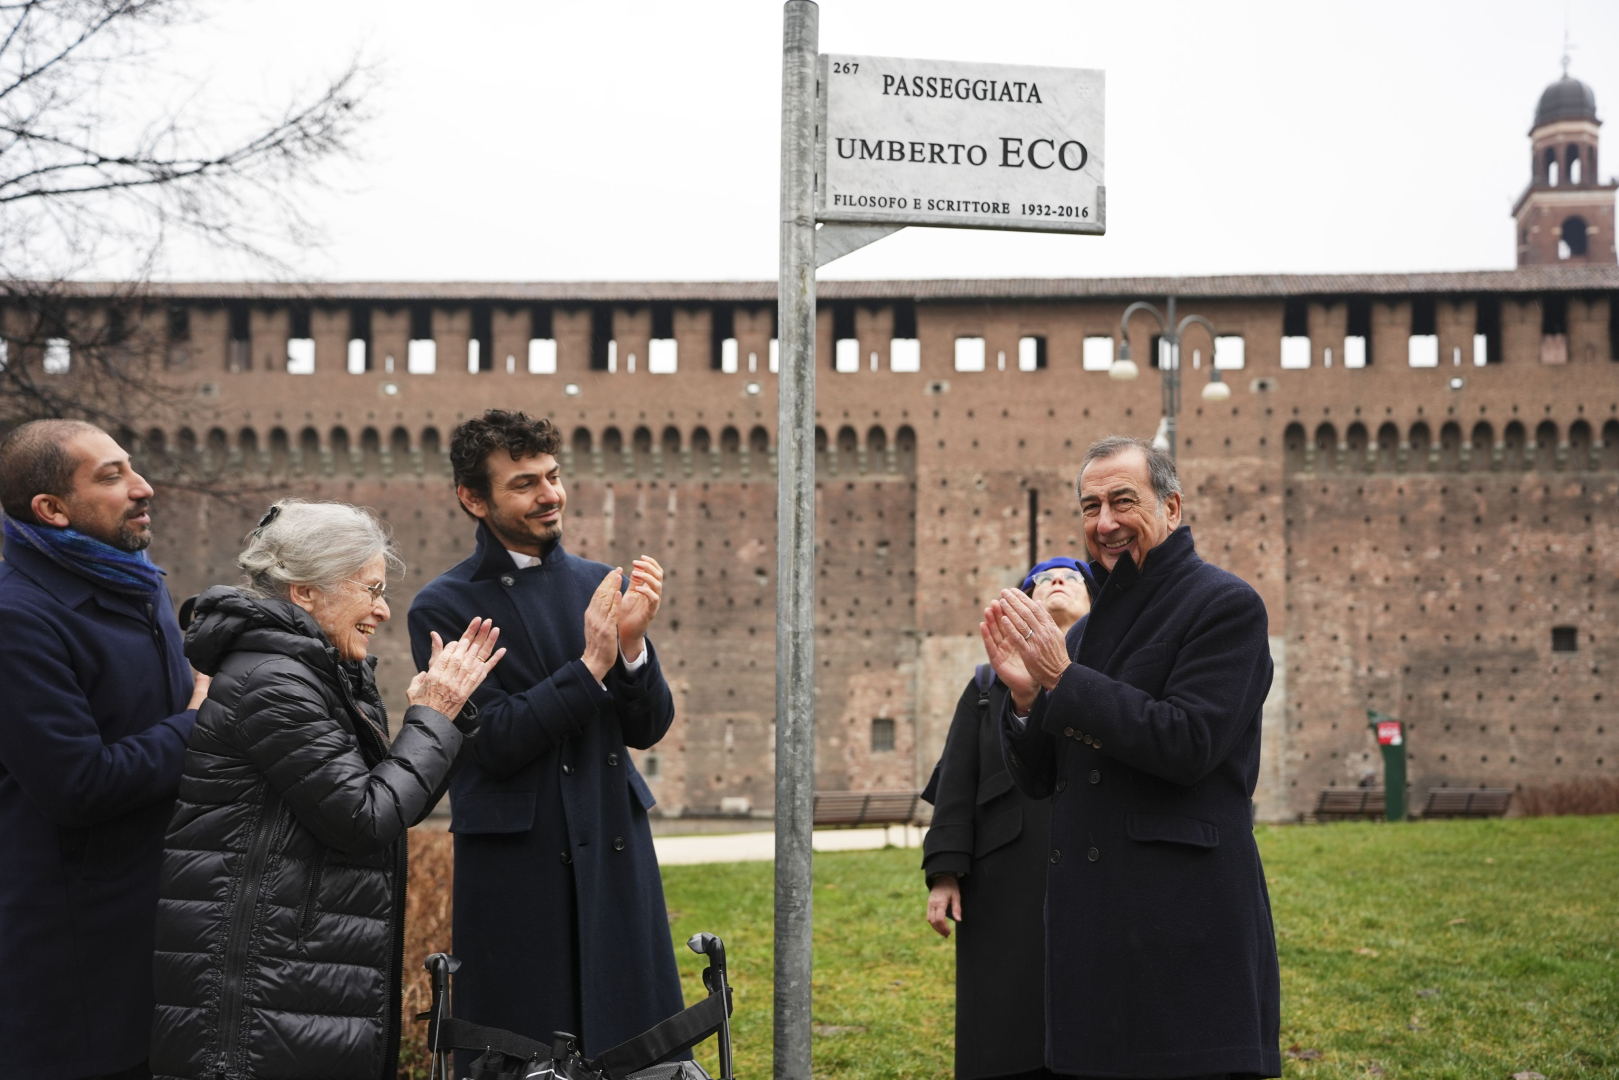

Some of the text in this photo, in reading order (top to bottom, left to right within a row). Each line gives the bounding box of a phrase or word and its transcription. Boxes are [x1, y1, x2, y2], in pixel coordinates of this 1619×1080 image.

[833, 62, 860, 75] 267
[882, 74, 1043, 104] PASSEGGIATA
[835, 137, 1088, 172] UMBERTO ECO
[834, 194, 1089, 218] FILOSOFO E SCRITTORE 1932-2016
